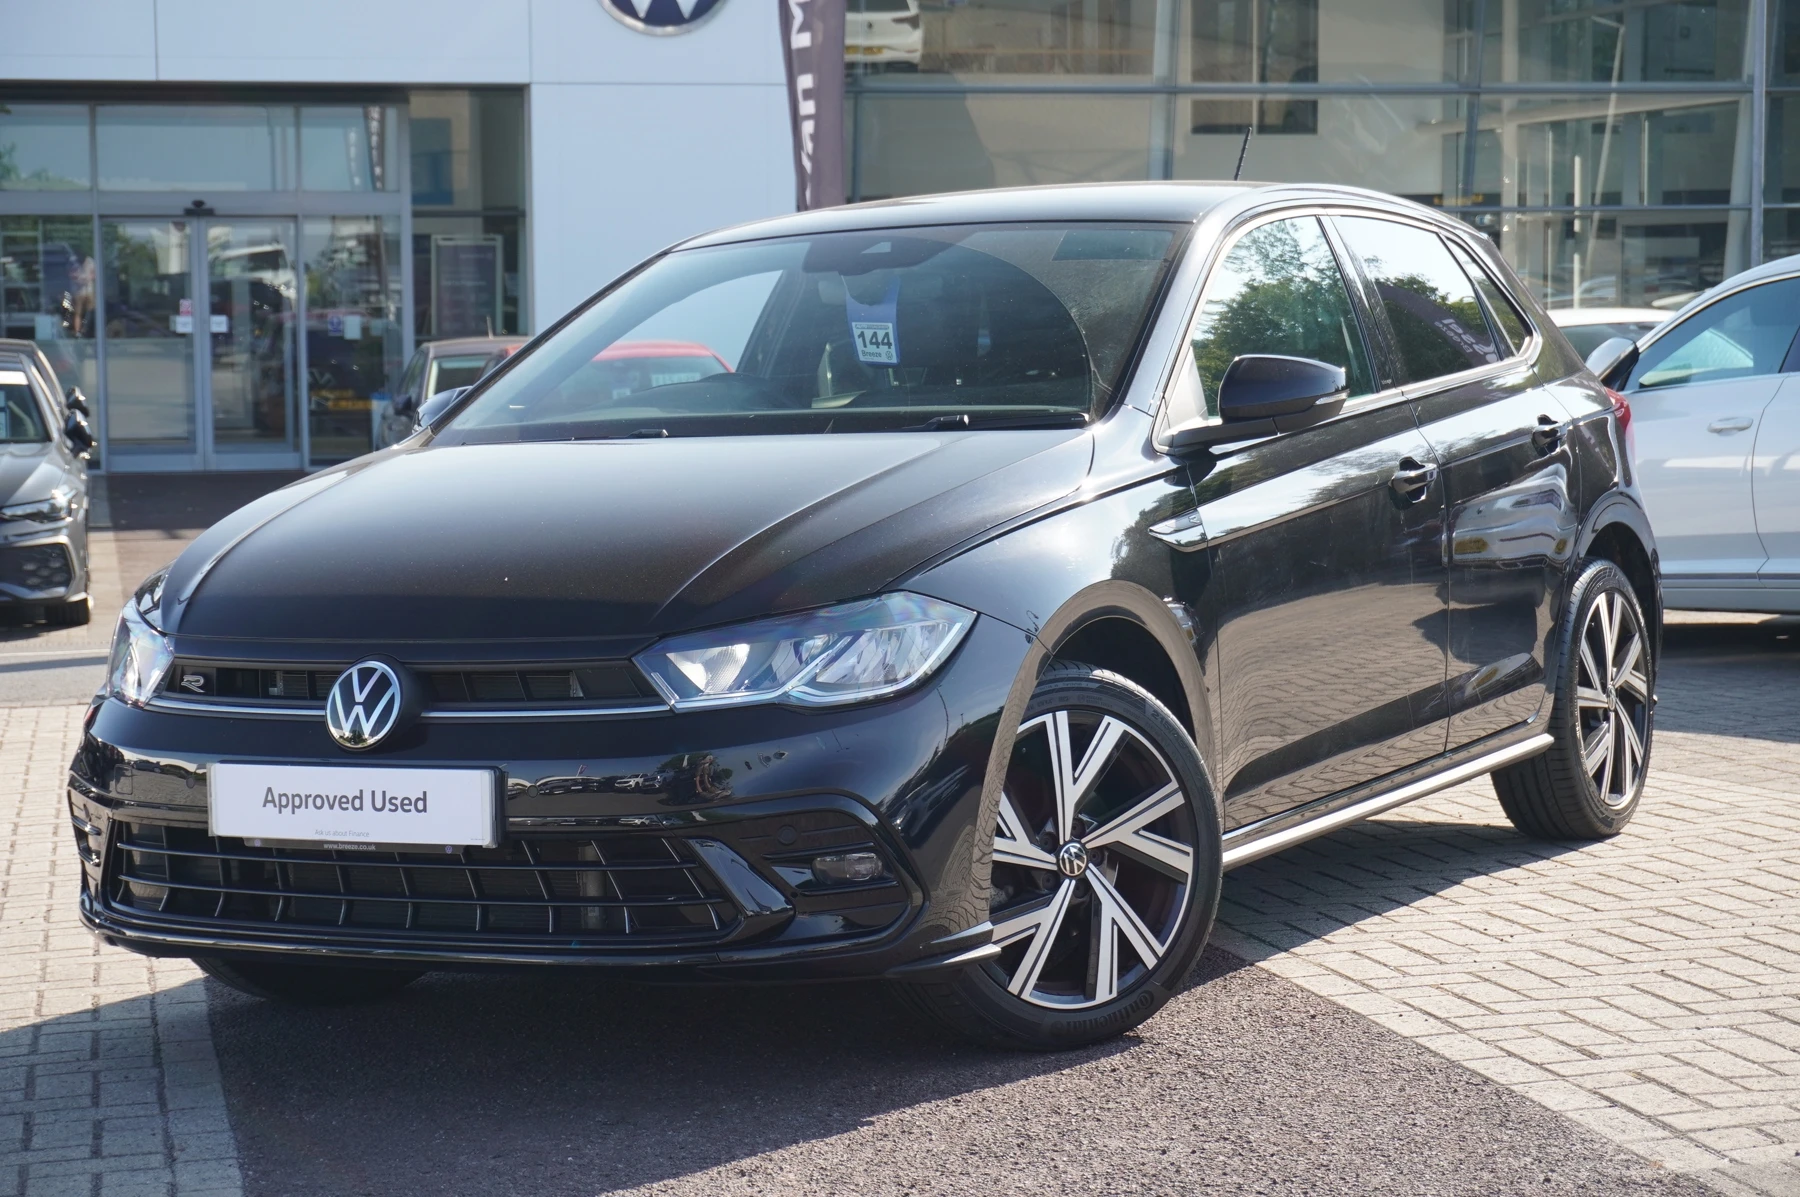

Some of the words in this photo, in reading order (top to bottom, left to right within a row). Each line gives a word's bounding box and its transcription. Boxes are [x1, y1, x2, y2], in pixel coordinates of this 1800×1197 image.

[857, 331, 892, 349] 144
[262, 786, 364, 815] Approved
[370, 790, 428, 814] Used
